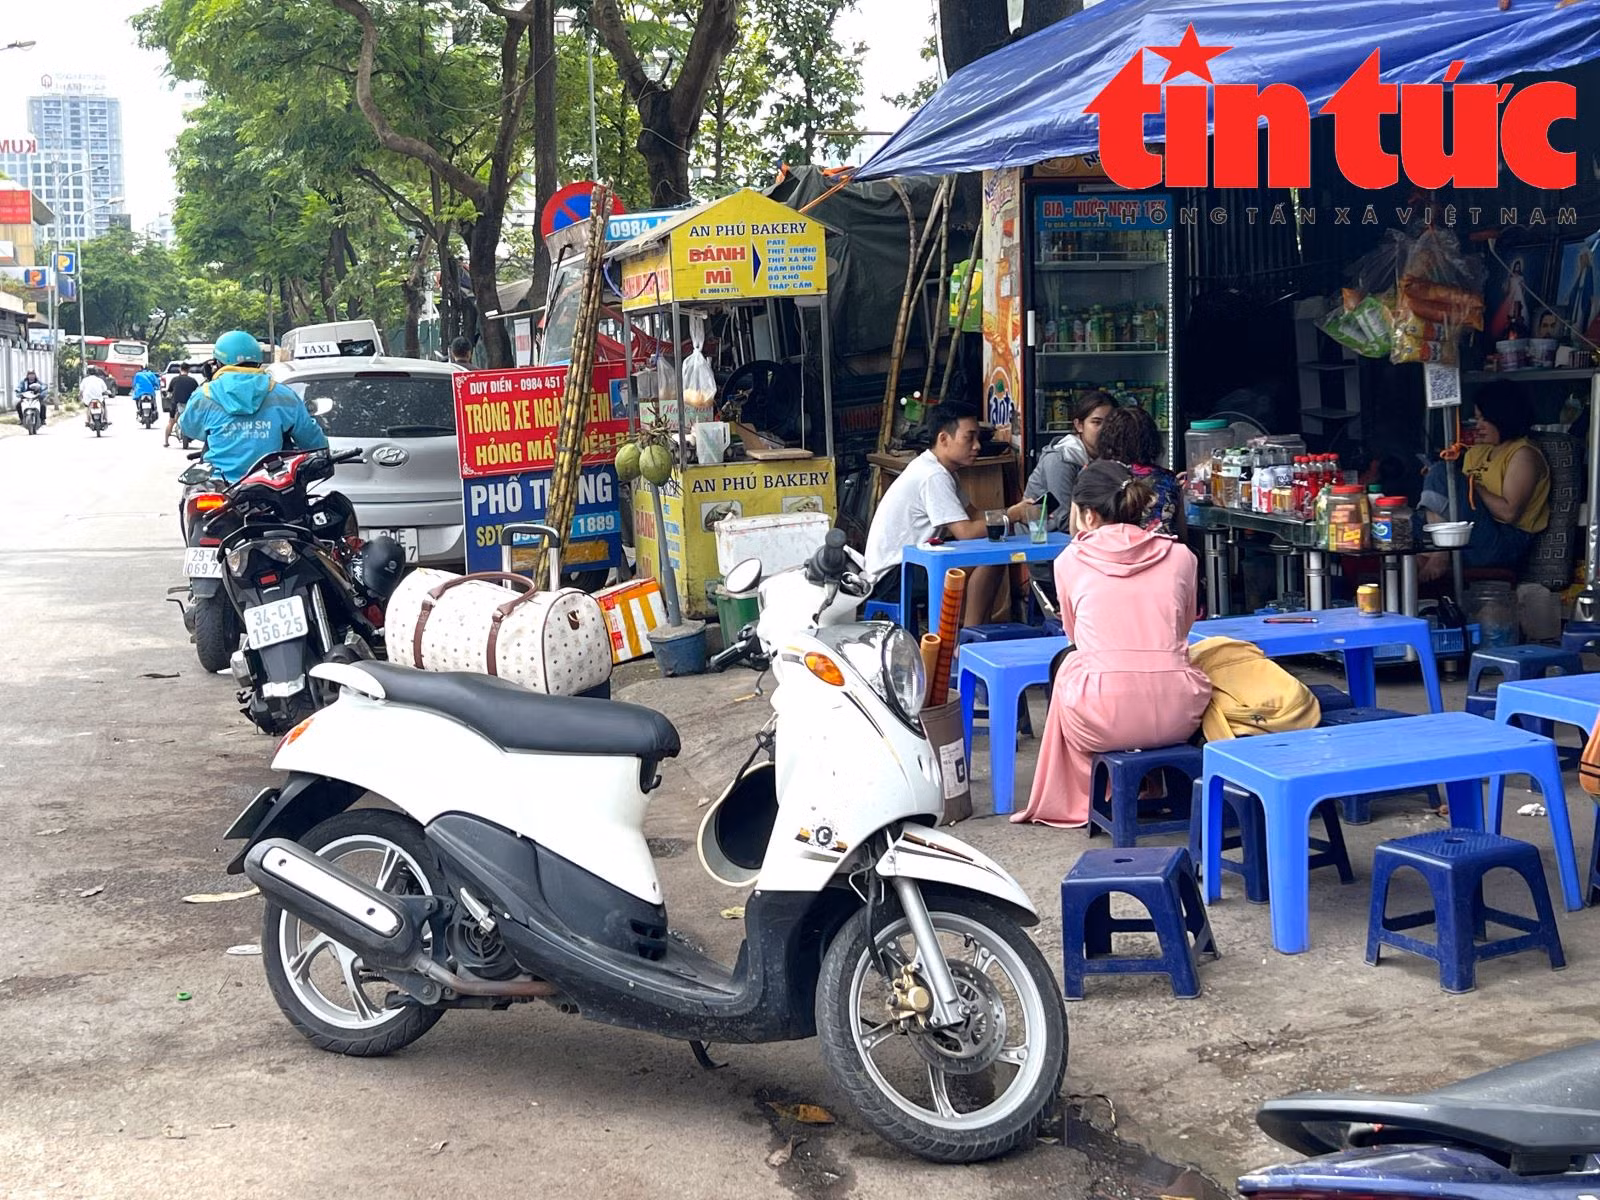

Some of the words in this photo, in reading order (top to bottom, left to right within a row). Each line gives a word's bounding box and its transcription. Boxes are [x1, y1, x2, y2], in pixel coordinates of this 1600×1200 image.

[1043, 201, 1064, 218] BIA
[689, 225, 710, 237] AN
[716, 221, 746, 237] PHÚ
[751, 222, 807, 235] BAKERY
[688, 245, 746, 262] BÁNH
[705, 267, 731, 284] MÌ
[302, 344, 330, 354] TAXI
[469, 381, 488, 395] DUY
[520, 378, 542, 391] 0984
[544, 376, 561, 389] 451
[255, 420, 271, 430] SM
[465, 397, 511, 434] TRÔNG
[513, 400, 531, 430] XE
[476, 438, 522, 466] HỎNG
[527, 431, 557, 461] MẤ
[692, 479, 715, 493] AN
[722, 471, 757, 491] PHÚ
[763, 471, 829, 489] BAKERY
[471, 473, 522, 516] PHỐ
[530, 472, 612, 510] TNG
[578, 514, 615, 534] 1889
[187, 562, 222, 575] 069.7
[253, 601, 294, 627] 34-C1
[252, 617, 303, 645] 156.25
